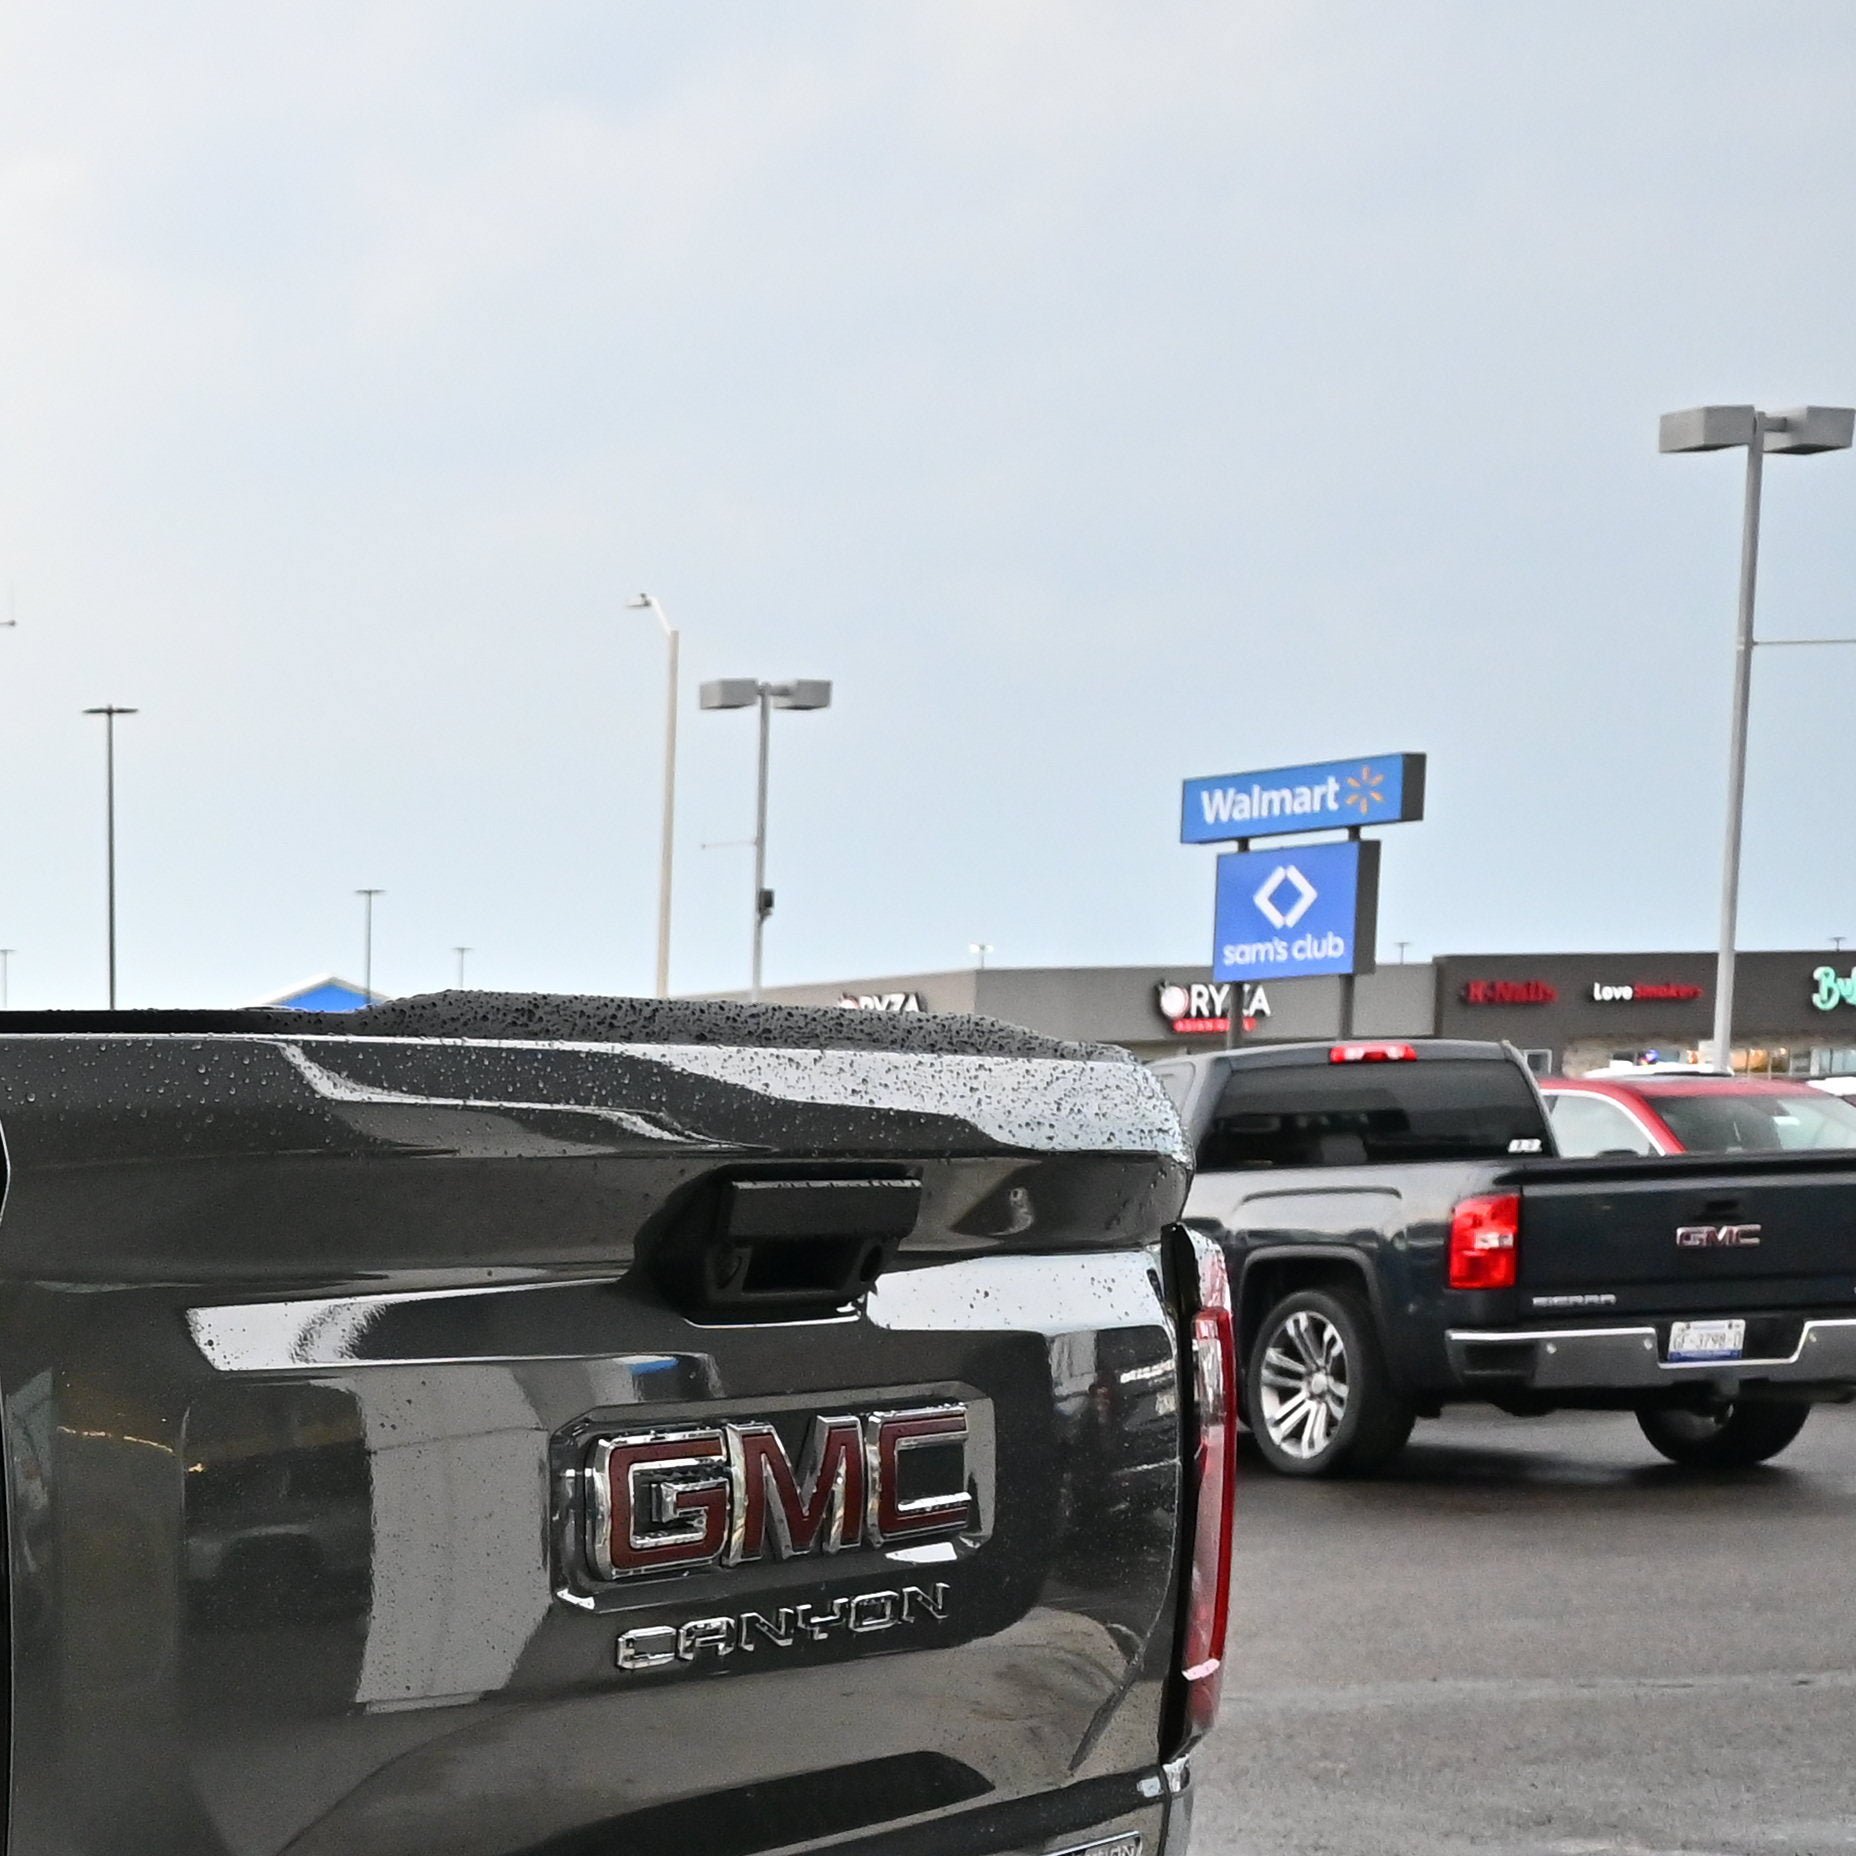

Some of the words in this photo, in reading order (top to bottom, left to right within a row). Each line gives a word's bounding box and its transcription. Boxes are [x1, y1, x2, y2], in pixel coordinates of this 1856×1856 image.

[1201, 775, 1340, 825] Walmart
[1223, 936, 1288, 967] sam's
[1292, 931, 1345, 962] club
[1675, 1223, 1762, 1247] GMC
[585, 1403, 972, 1581] GMC
[617, 1582, 950, 1670] CANYON
